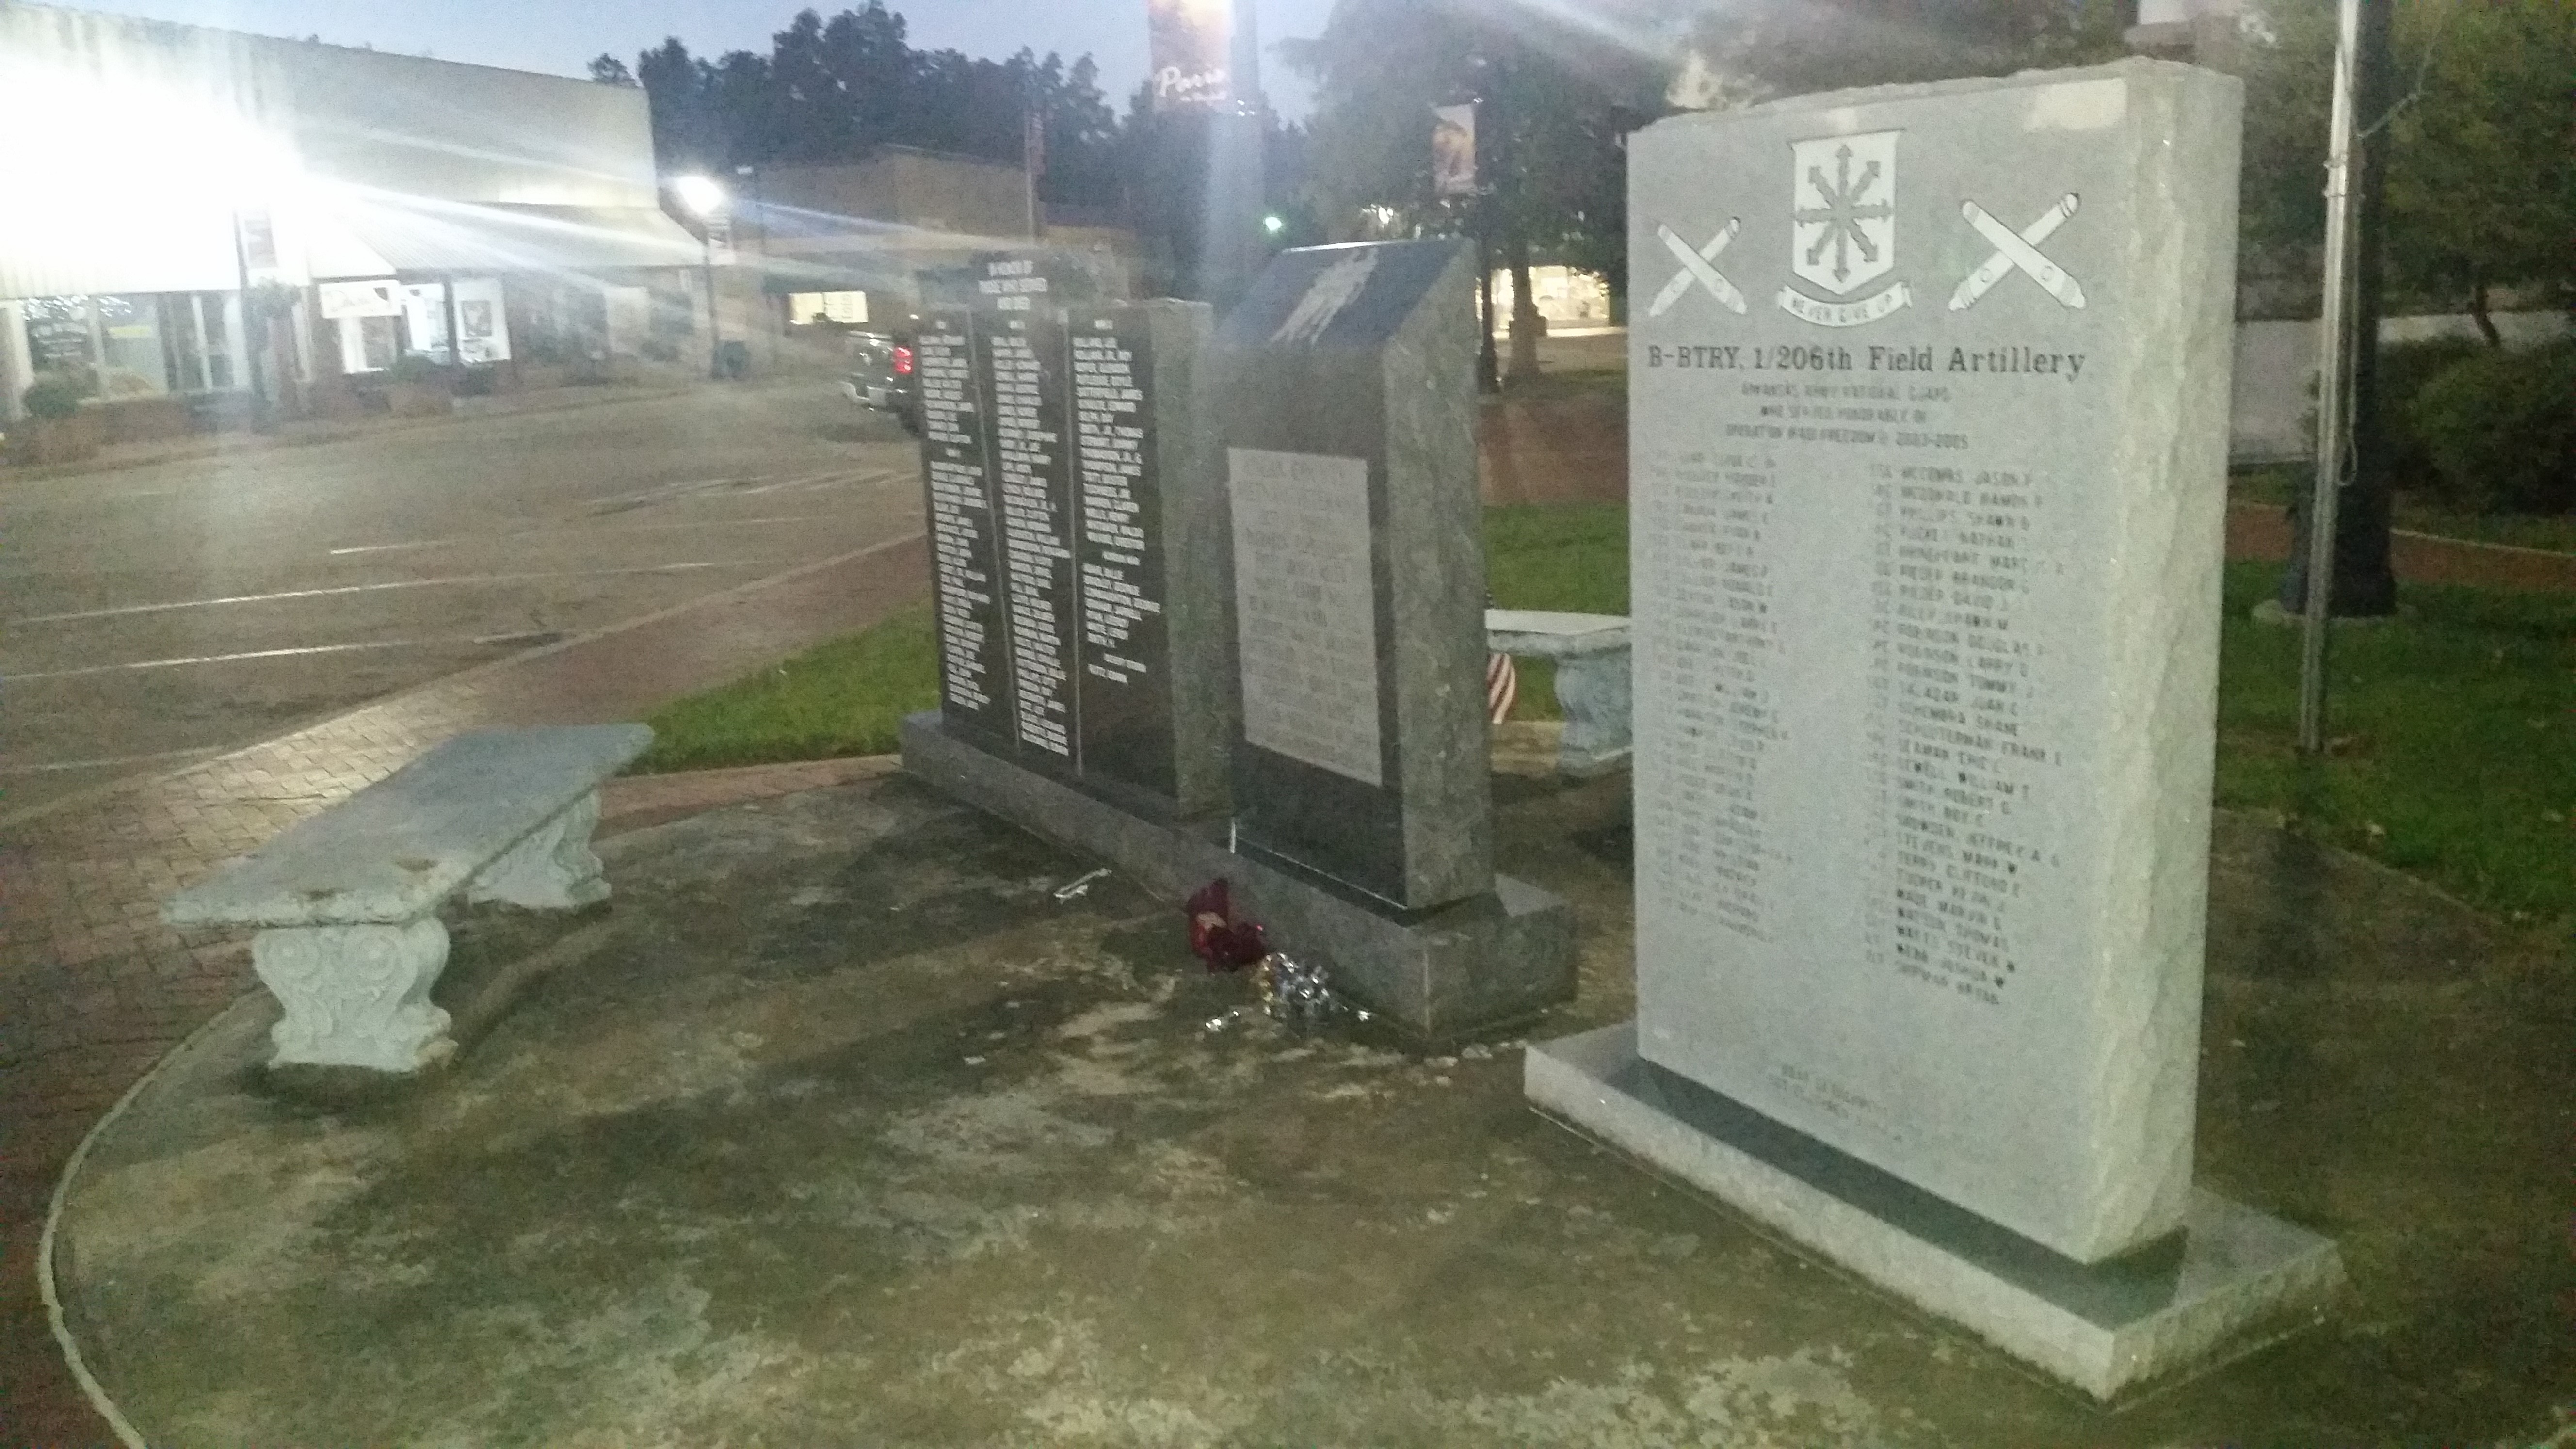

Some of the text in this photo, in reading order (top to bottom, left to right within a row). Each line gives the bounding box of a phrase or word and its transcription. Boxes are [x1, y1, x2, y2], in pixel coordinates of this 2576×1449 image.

[1754, 345, 1852, 370] 1/206th
[1869, 344, 1933, 371] Field
[1948, 346, 2085, 383] Artillery
